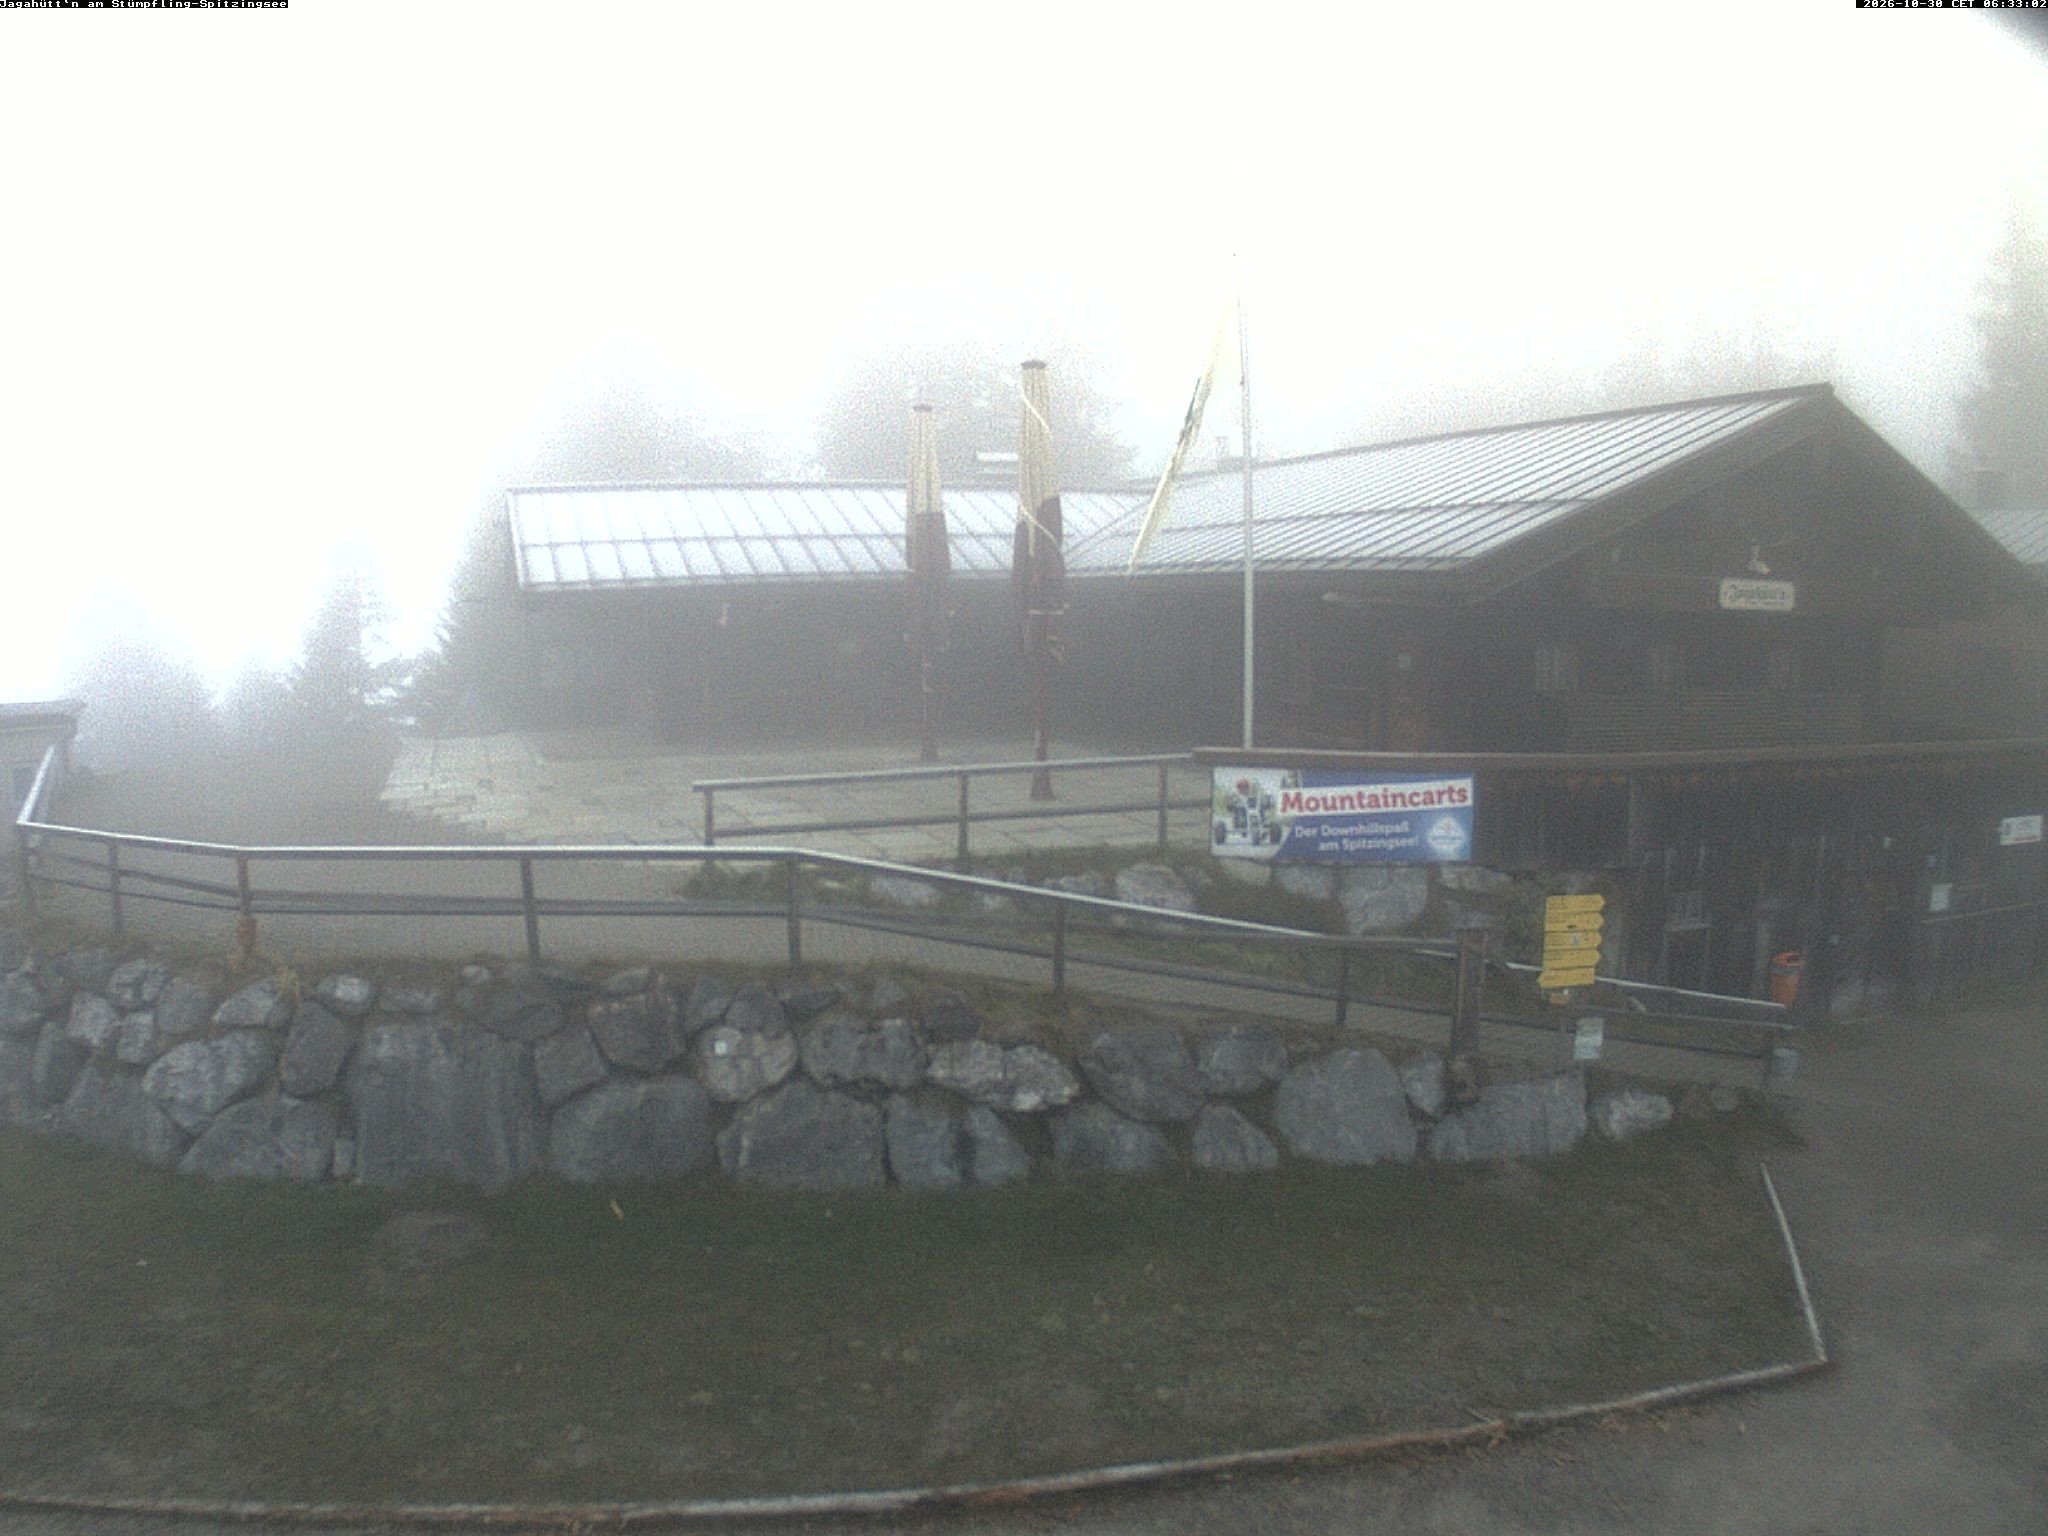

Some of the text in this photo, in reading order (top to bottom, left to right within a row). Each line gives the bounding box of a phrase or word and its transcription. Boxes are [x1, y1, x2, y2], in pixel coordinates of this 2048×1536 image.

[1281, 785, 1468, 813] Mountaincarts
[1295, 826, 1317, 838] Der
[1319, 842, 1339, 851] am
